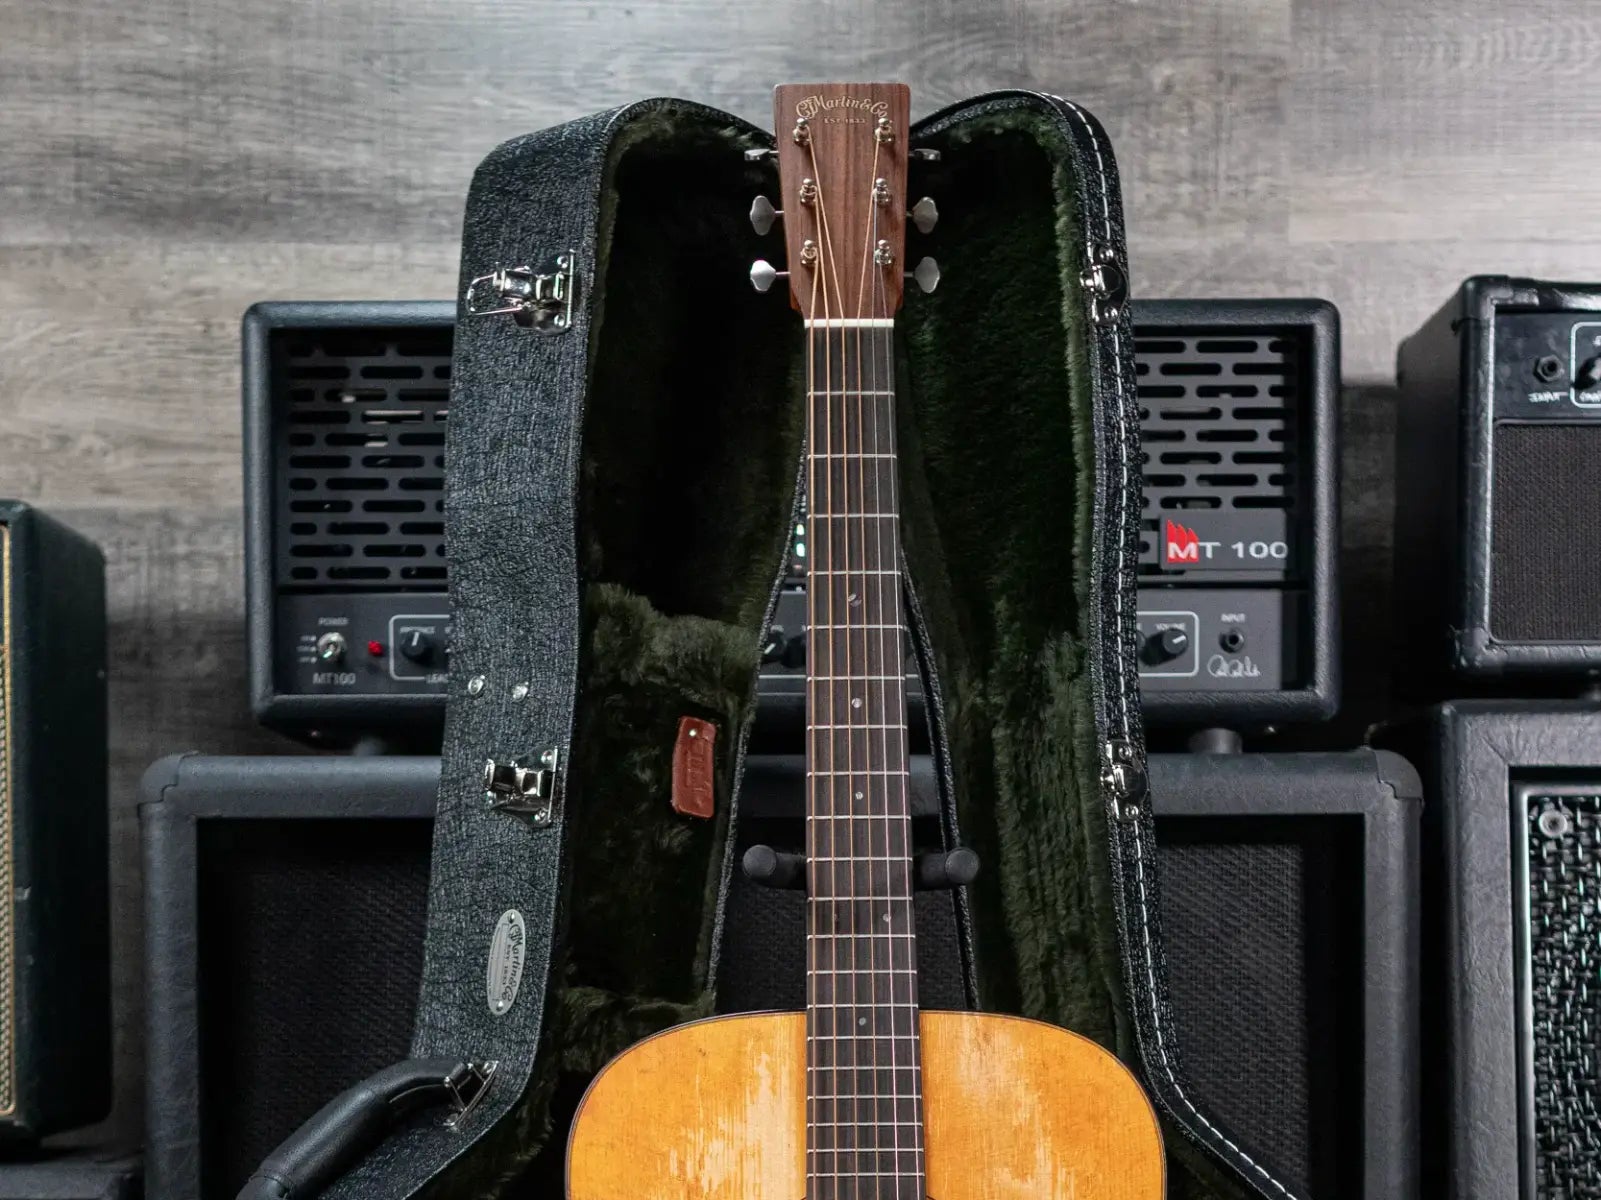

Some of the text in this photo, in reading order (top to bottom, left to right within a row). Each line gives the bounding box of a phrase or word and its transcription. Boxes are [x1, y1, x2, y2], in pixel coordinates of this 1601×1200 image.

[1168, 541, 1289, 560] MT 100
[1221, 613, 1246, 623] INPUT
[313, 673, 356, 685] MT100
